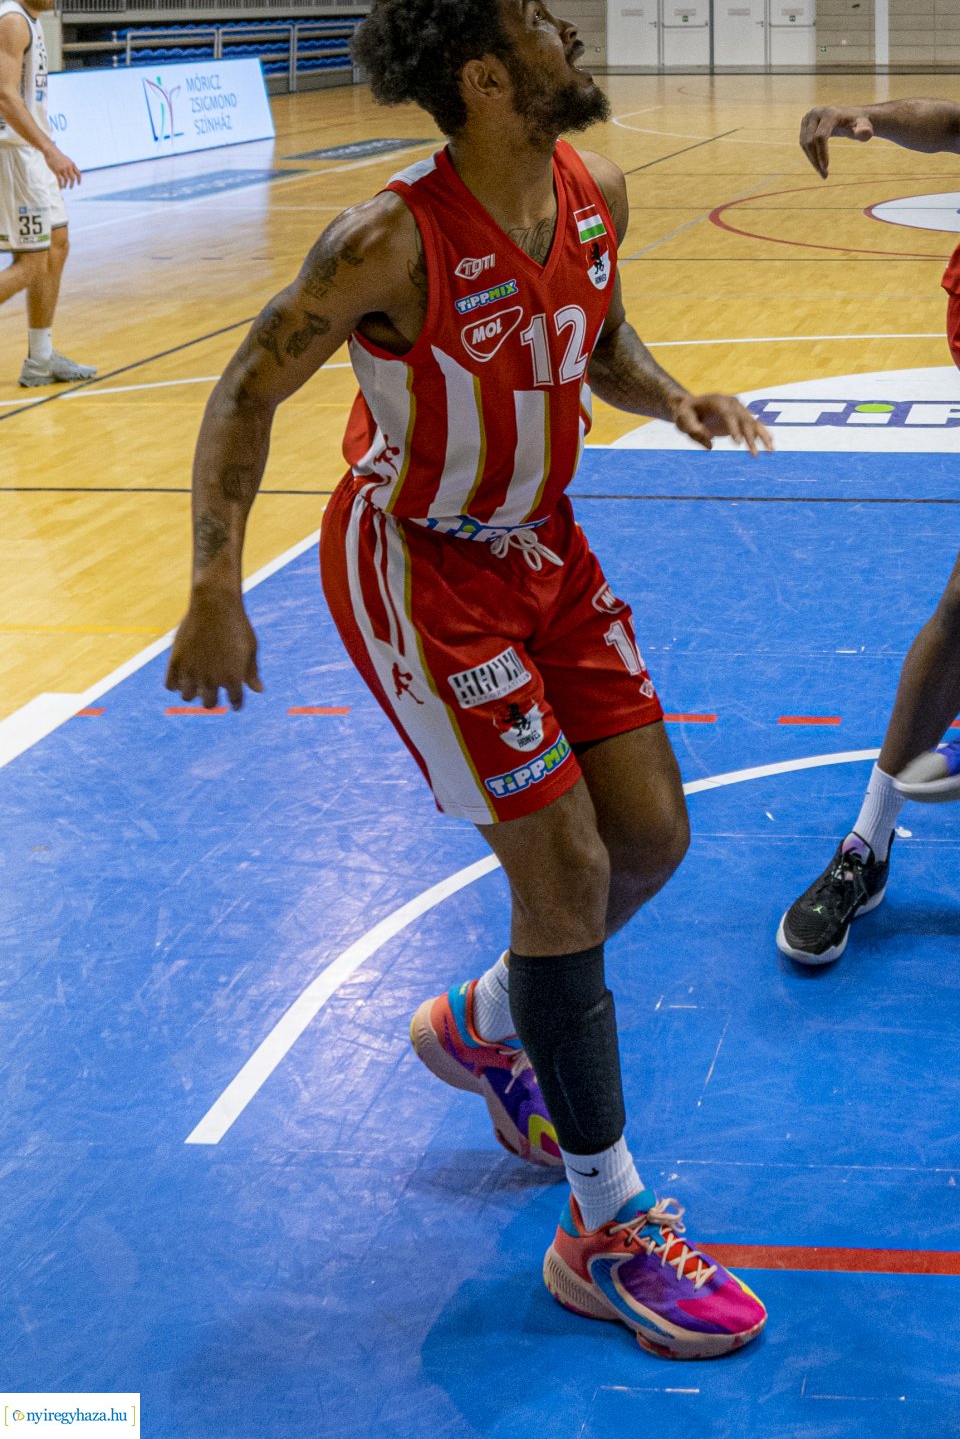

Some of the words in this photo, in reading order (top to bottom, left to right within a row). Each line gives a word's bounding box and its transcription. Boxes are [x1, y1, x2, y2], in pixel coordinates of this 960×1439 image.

[186, 74, 222, 92] MÓRICZ
[190, 93, 238, 113] ZSIGMOND
[194, 115, 233, 135] SZÍNHÁZ
[19, 215, 42, 236] 35
[472, 318, 503, 345] MOL
[520, 304, 589, 387] 12
